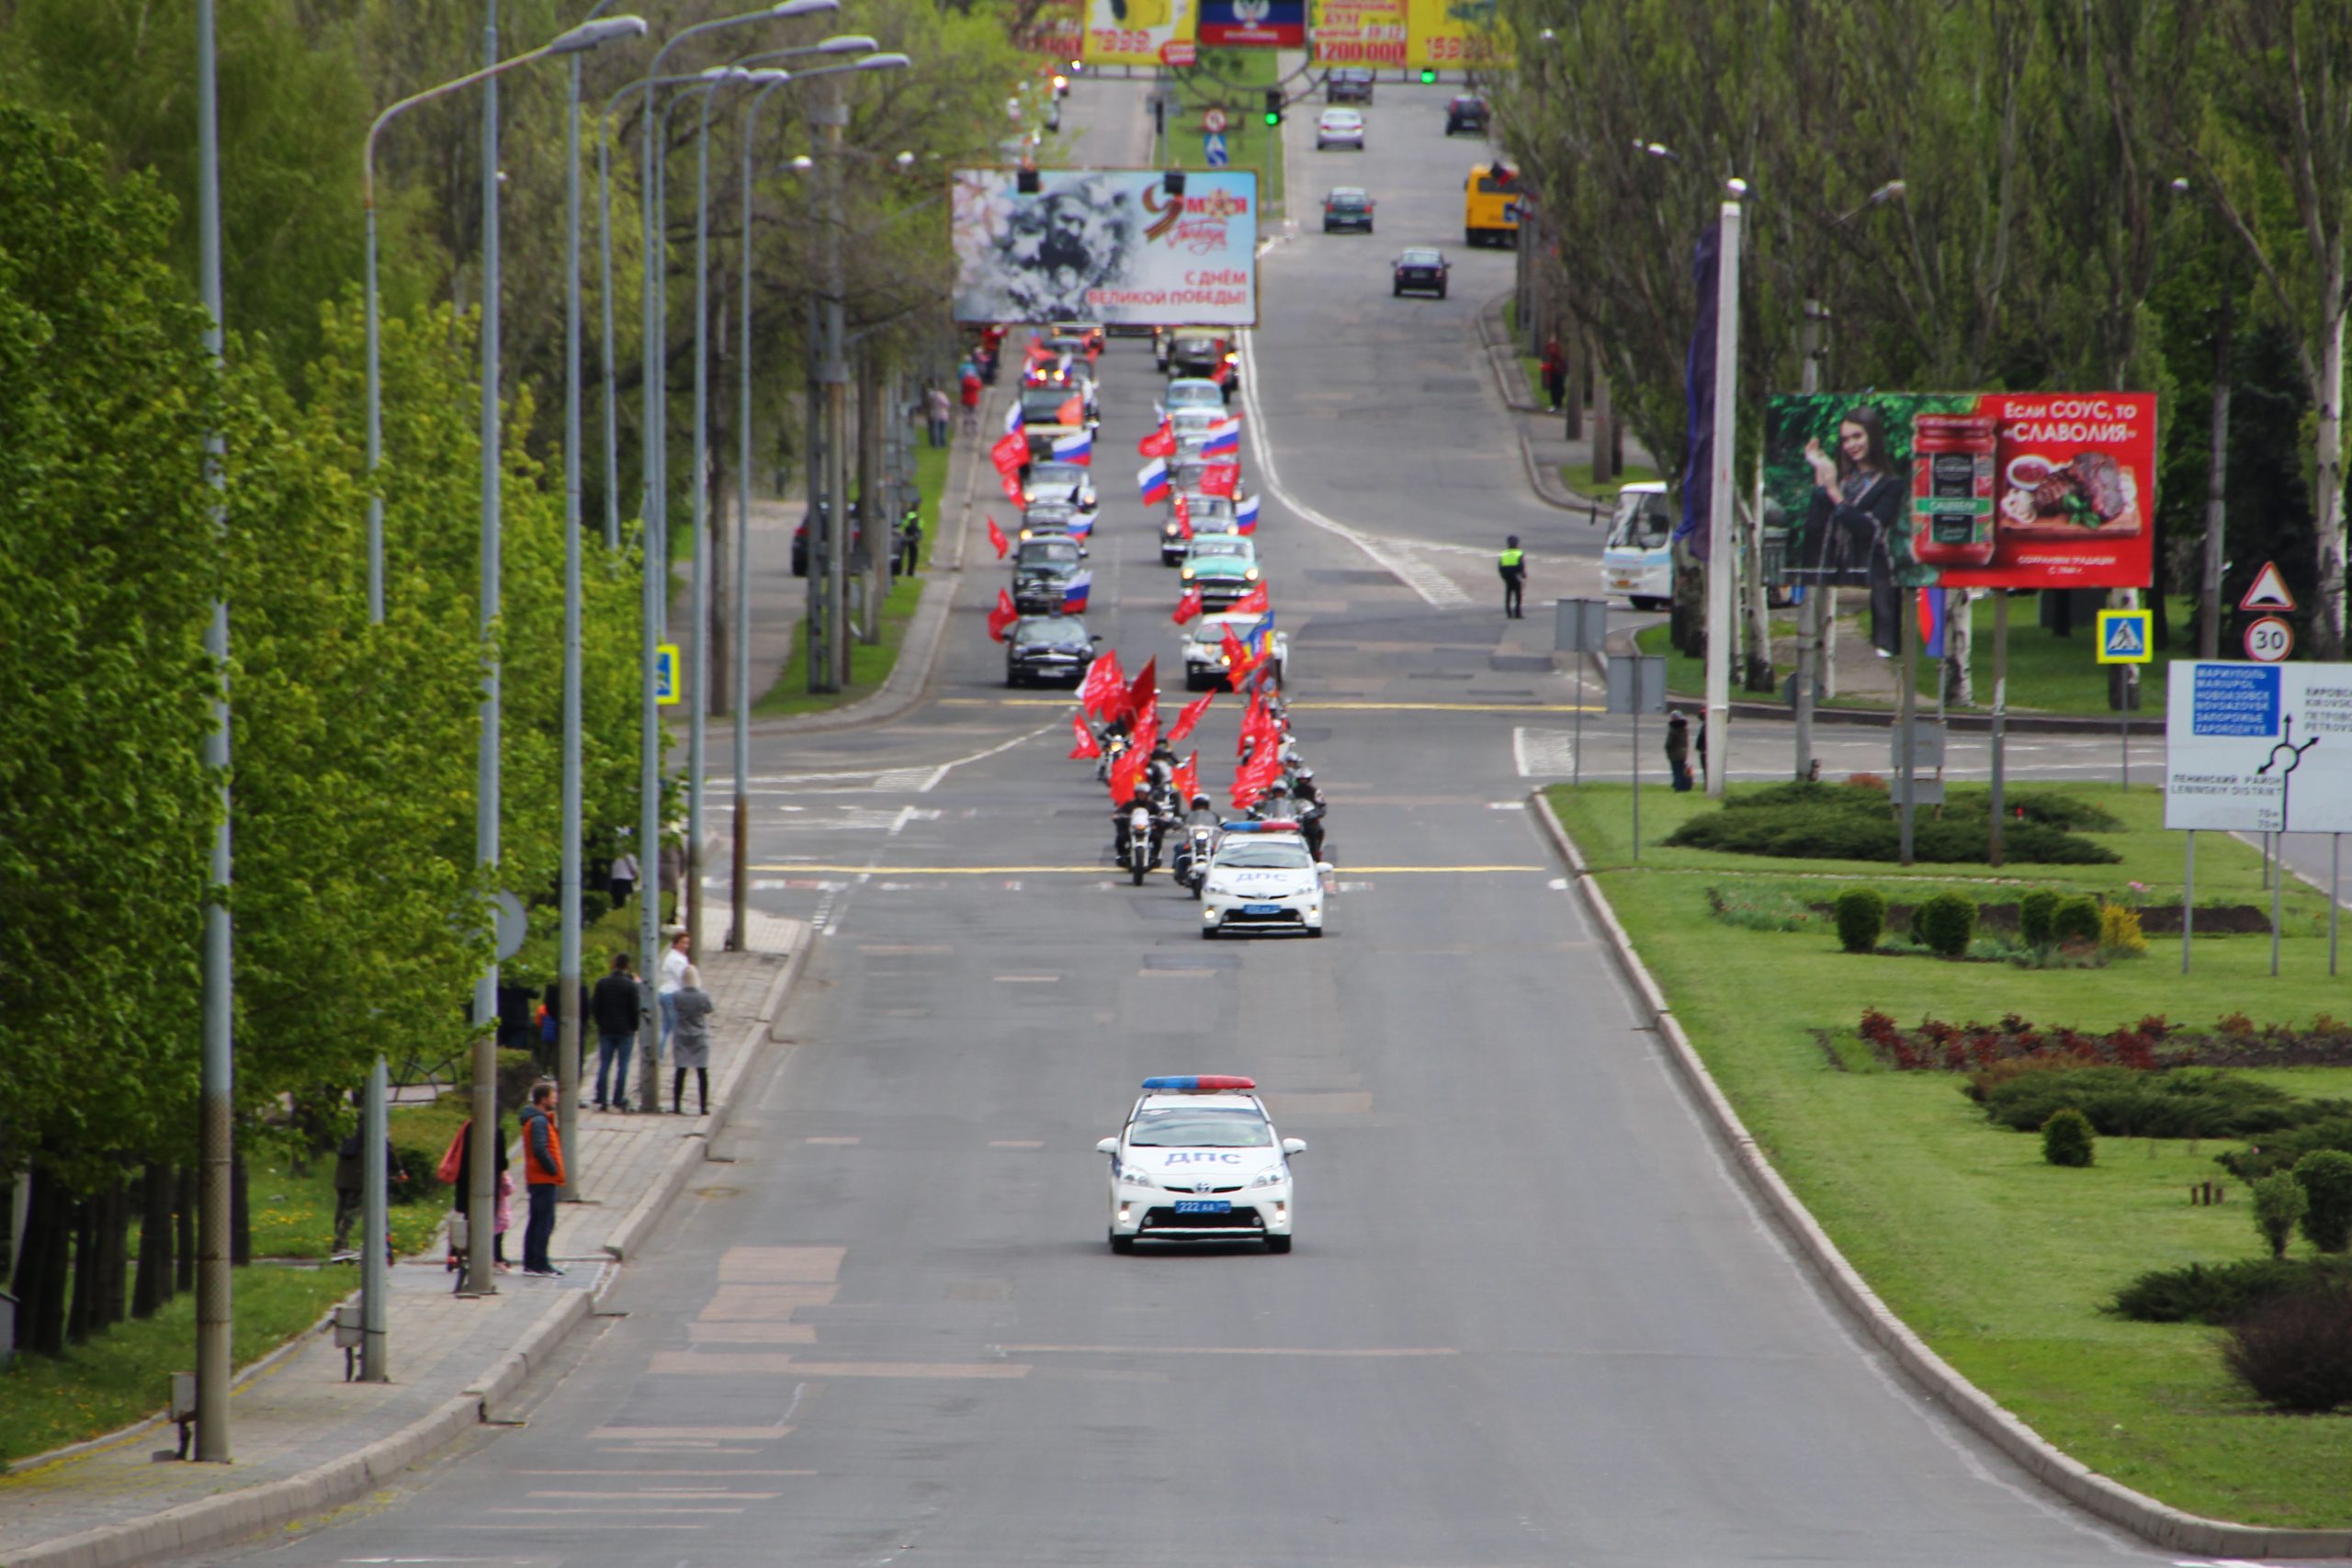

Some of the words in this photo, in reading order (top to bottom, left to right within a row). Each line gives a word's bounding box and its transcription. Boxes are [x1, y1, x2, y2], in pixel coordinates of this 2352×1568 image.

[1184, 271, 1196, 287] С
[1199, 268, 1247, 288] ДНЁМ
[1088, 288, 1166, 306] ВЕЛИКОЙ
[2255, 631, 2284, 649] 30
[1236, 872, 1288, 883] ДПС
[1165, 1152, 1243, 1167] ДПС
